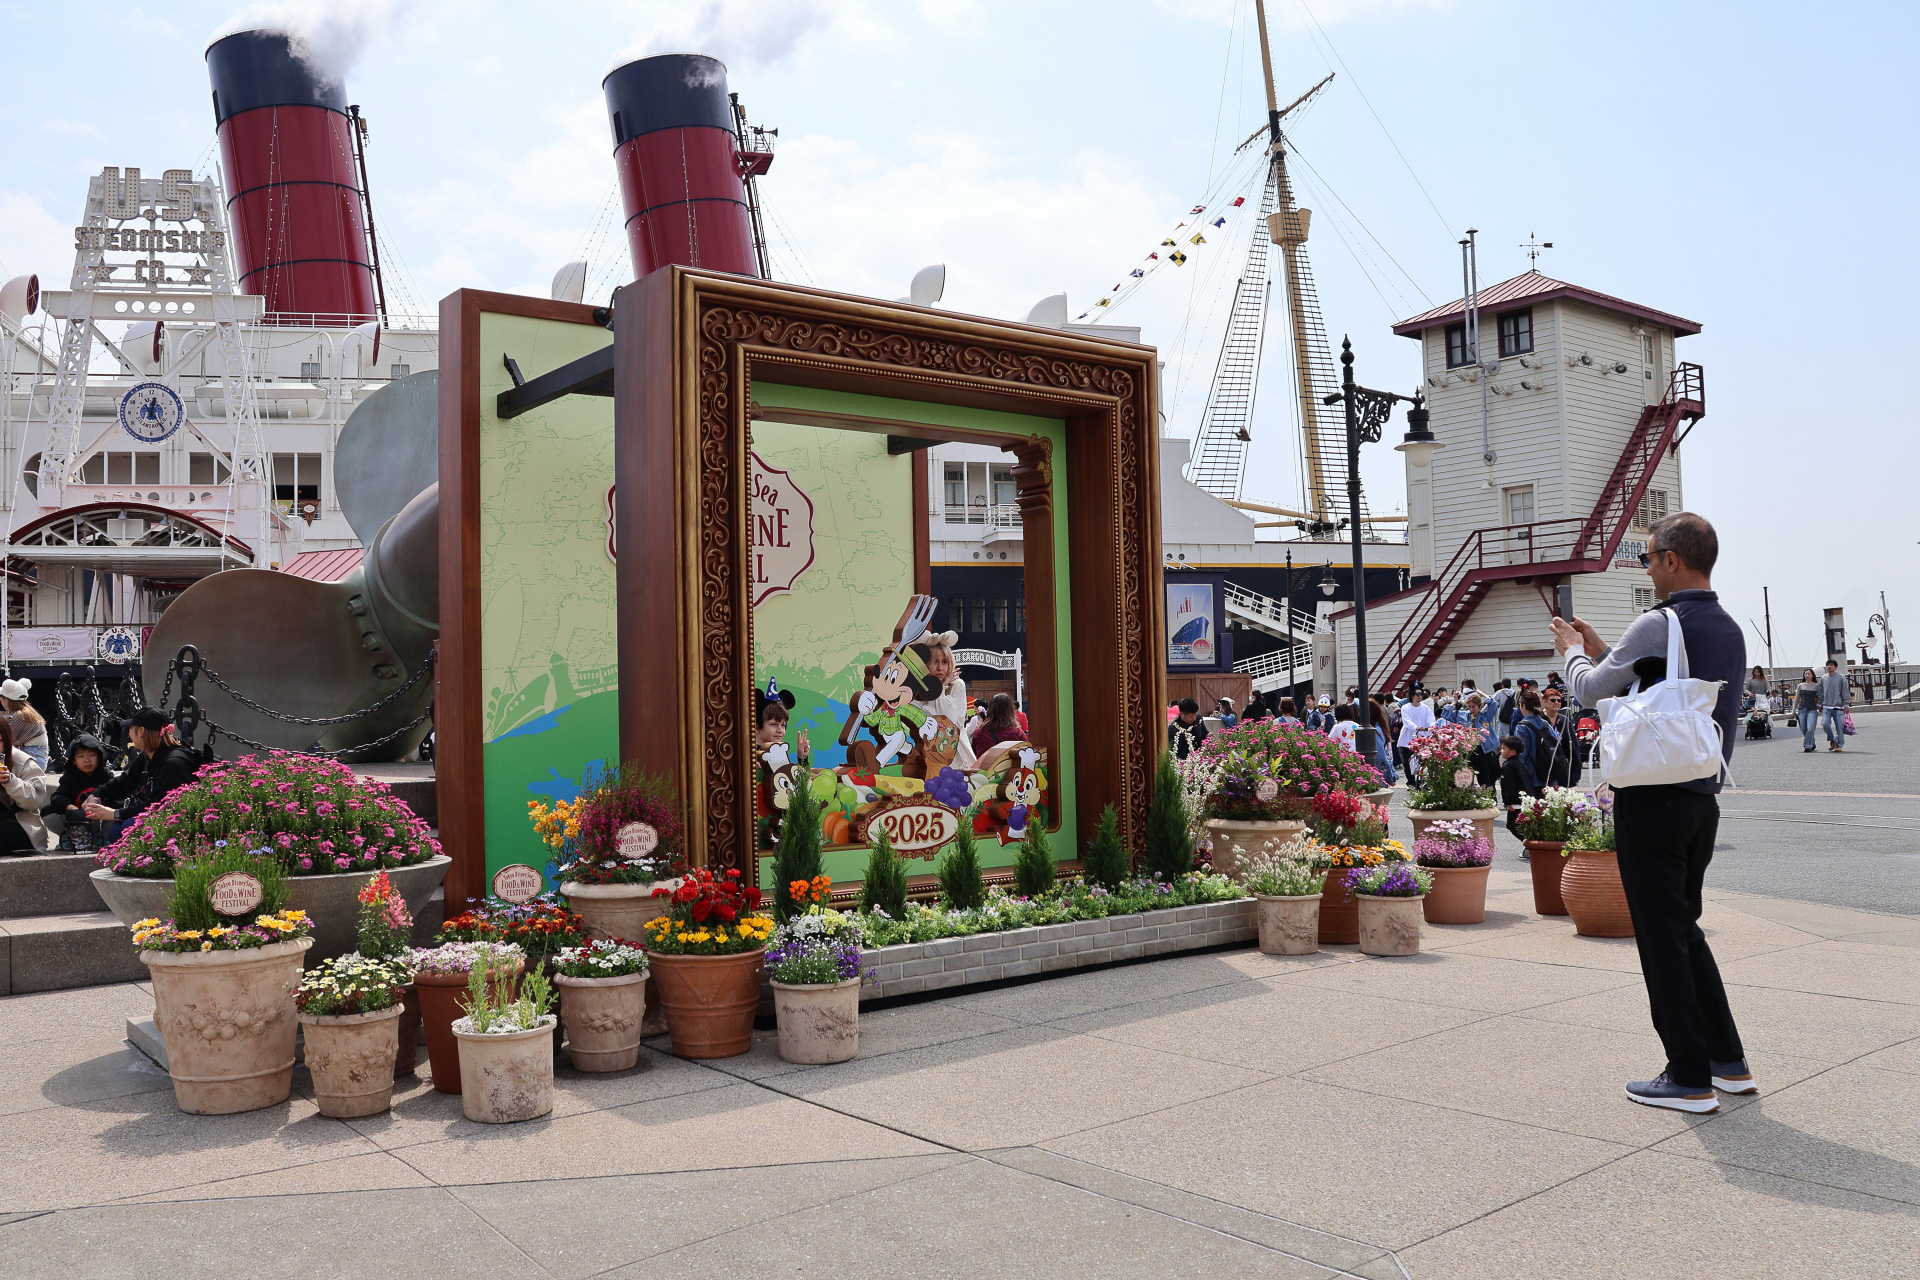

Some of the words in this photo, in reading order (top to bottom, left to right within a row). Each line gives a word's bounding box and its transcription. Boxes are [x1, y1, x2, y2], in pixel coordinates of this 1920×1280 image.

[103, 166, 210, 222] U.S.
[75, 226, 224, 253] STEAMSHIP
[135, 260, 173, 284] CO.
[752, 473, 778, 507] Sea
[752, 508, 790, 547] INE
[101, 650, 124, 664] STEAMSHI
[962, 652, 984, 662] CARGO
[986, 654, 1002, 666] ONLY
[884, 812, 944, 845] 2025
[637, 834, 652, 843] WINE
[625, 844, 647, 852] FESTIVAL
[502, 880, 516, 889] FOOD
[520, 879, 535, 888] WINE
[216, 889, 233, 899] FOOD
[238, 888, 256, 898] WINE
[222, 899, 250, 907] FESTIVAL
